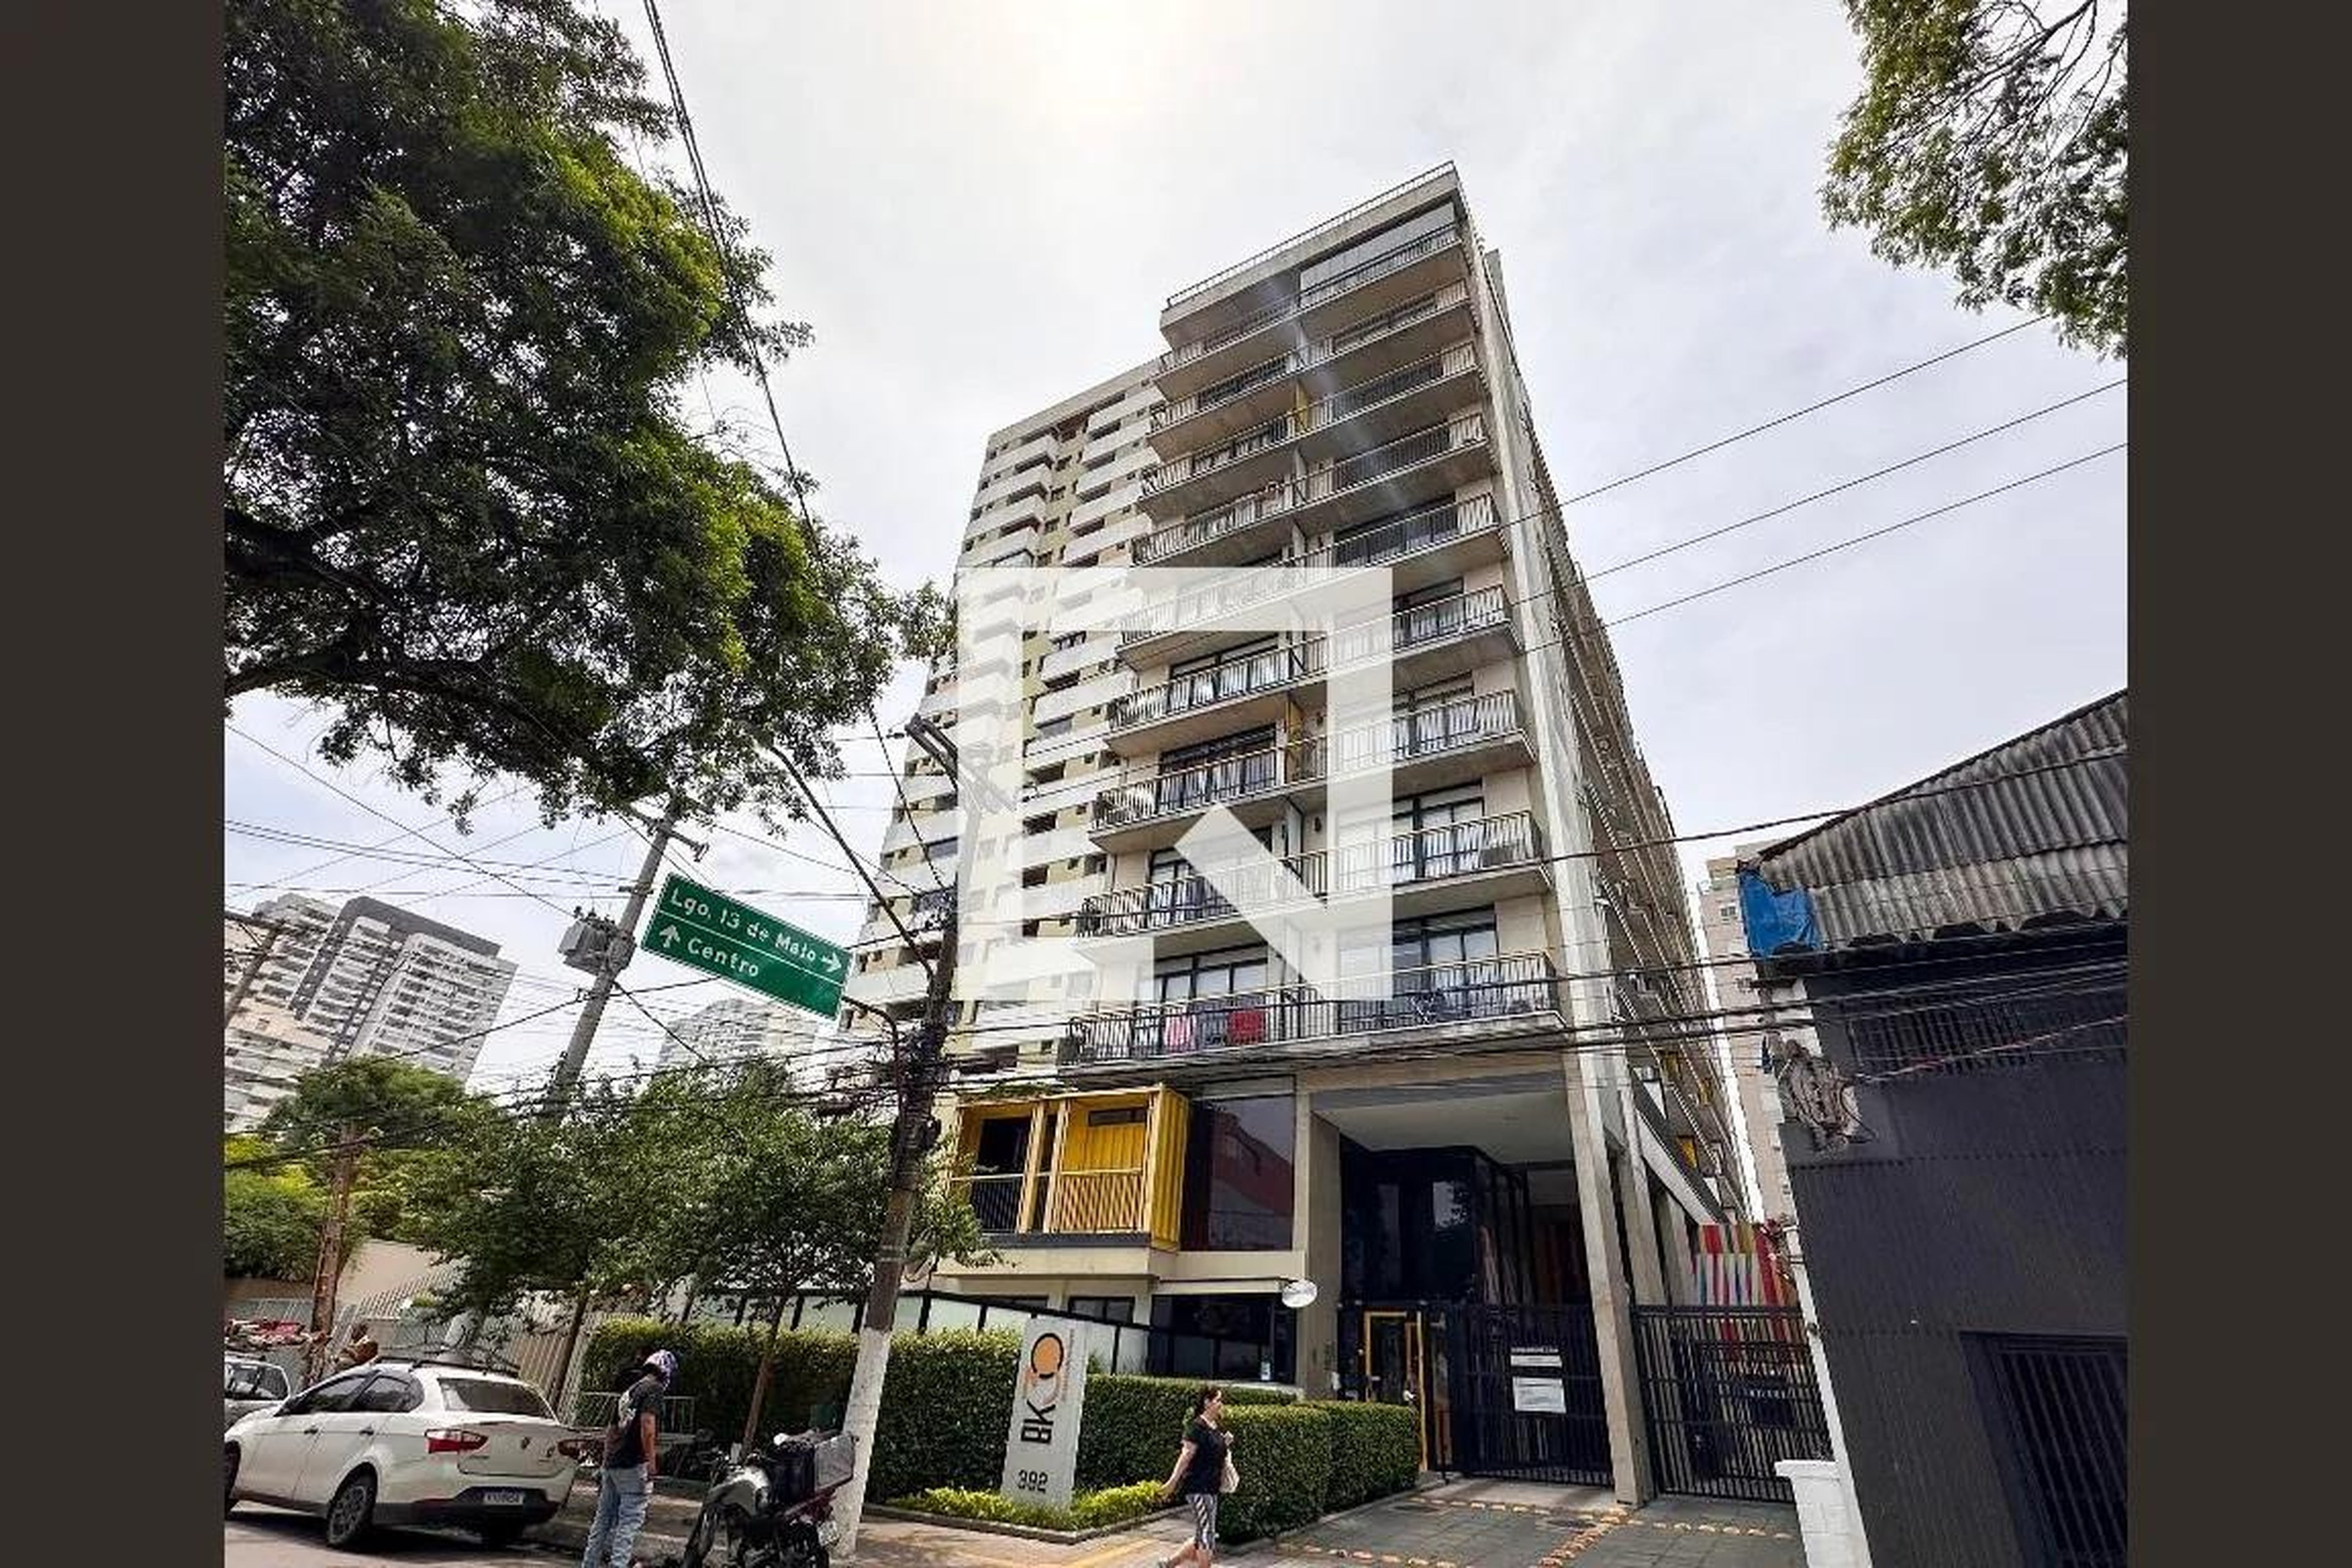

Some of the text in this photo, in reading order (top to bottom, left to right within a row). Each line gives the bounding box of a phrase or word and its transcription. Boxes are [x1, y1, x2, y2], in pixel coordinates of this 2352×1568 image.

[719, 908, 741, 929] 13
[746, 921, 769, 942] de
[774, 932, 817, 962] Maio
[687, 937, 760, 978] Centro
[1017, 1469, 1048, 1494] 392
